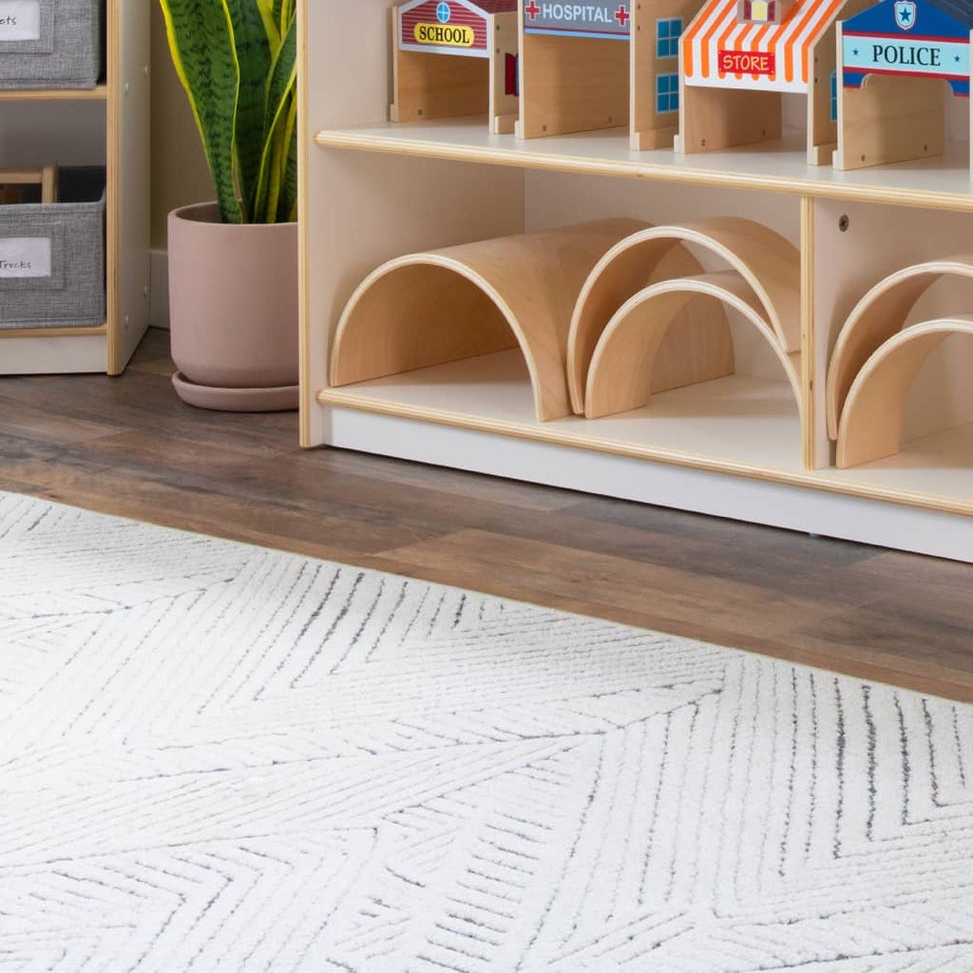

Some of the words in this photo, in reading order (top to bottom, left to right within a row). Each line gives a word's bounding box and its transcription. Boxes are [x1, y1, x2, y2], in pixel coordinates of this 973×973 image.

[542, 3, 613, 23] HOSPITAL
[419, 25, 470, 44] SCHOOL
[723, 54, 769, 71] STORE
[872, 44, 941, 66] POLICE
